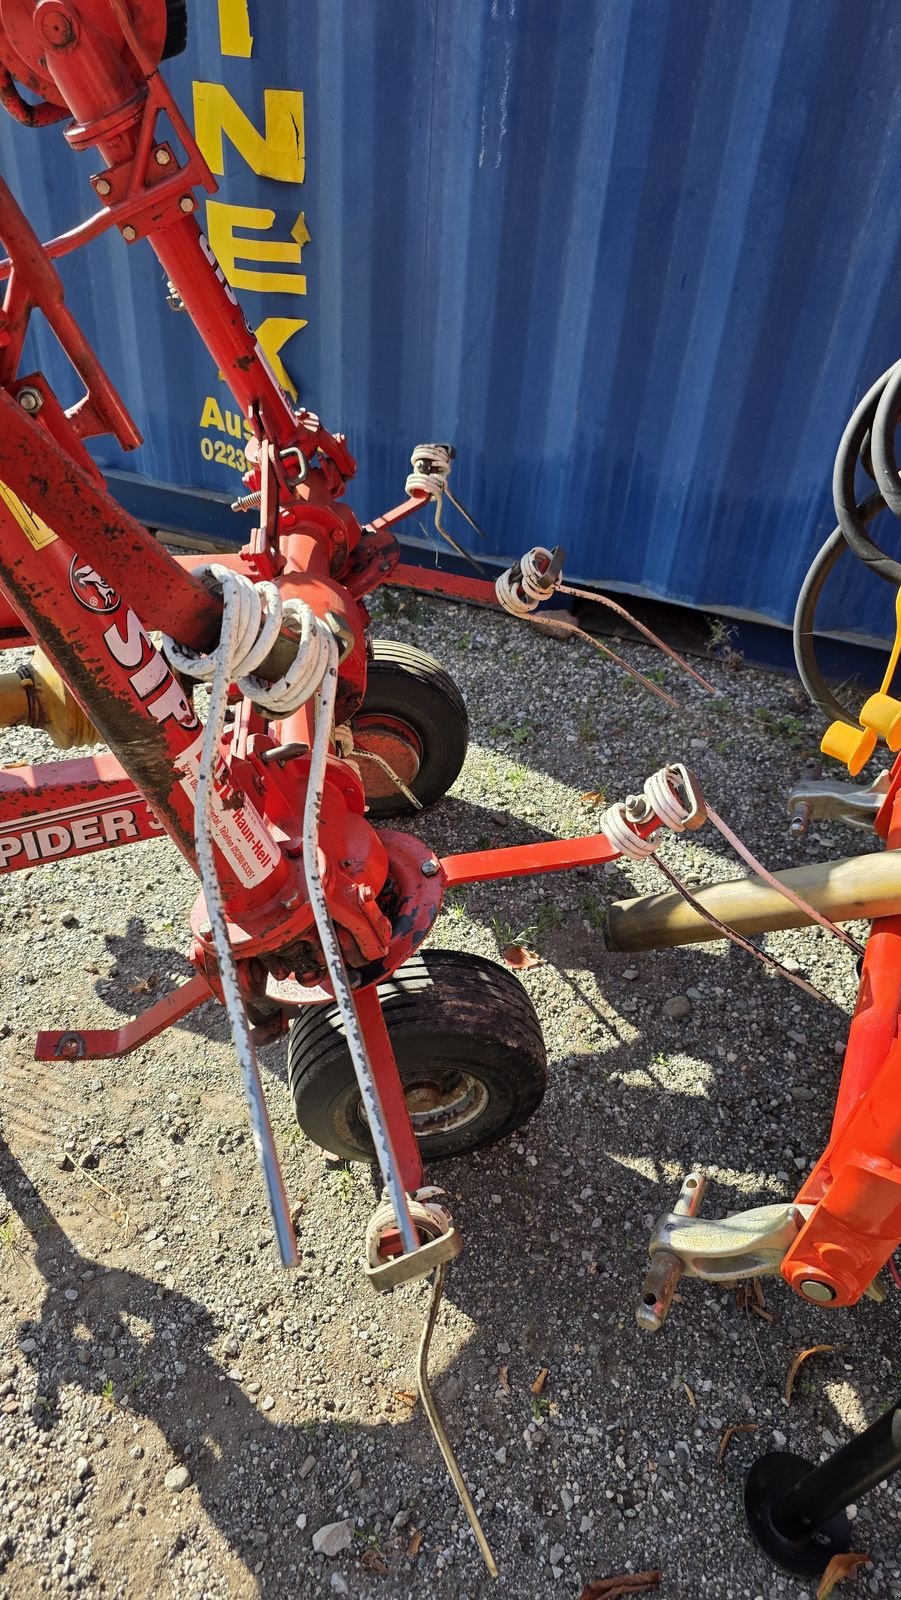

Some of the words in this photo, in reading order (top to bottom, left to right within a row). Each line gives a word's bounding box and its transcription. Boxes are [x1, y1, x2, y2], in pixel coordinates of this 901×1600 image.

[201, 437, 253, 473] 0223
[103, 608, 198, 730] SIP
[0, 809, 138, 867] PIDER
[219, 825, 233, 849] Telefon
[232, 808, 272, 868] Haun-Hell
